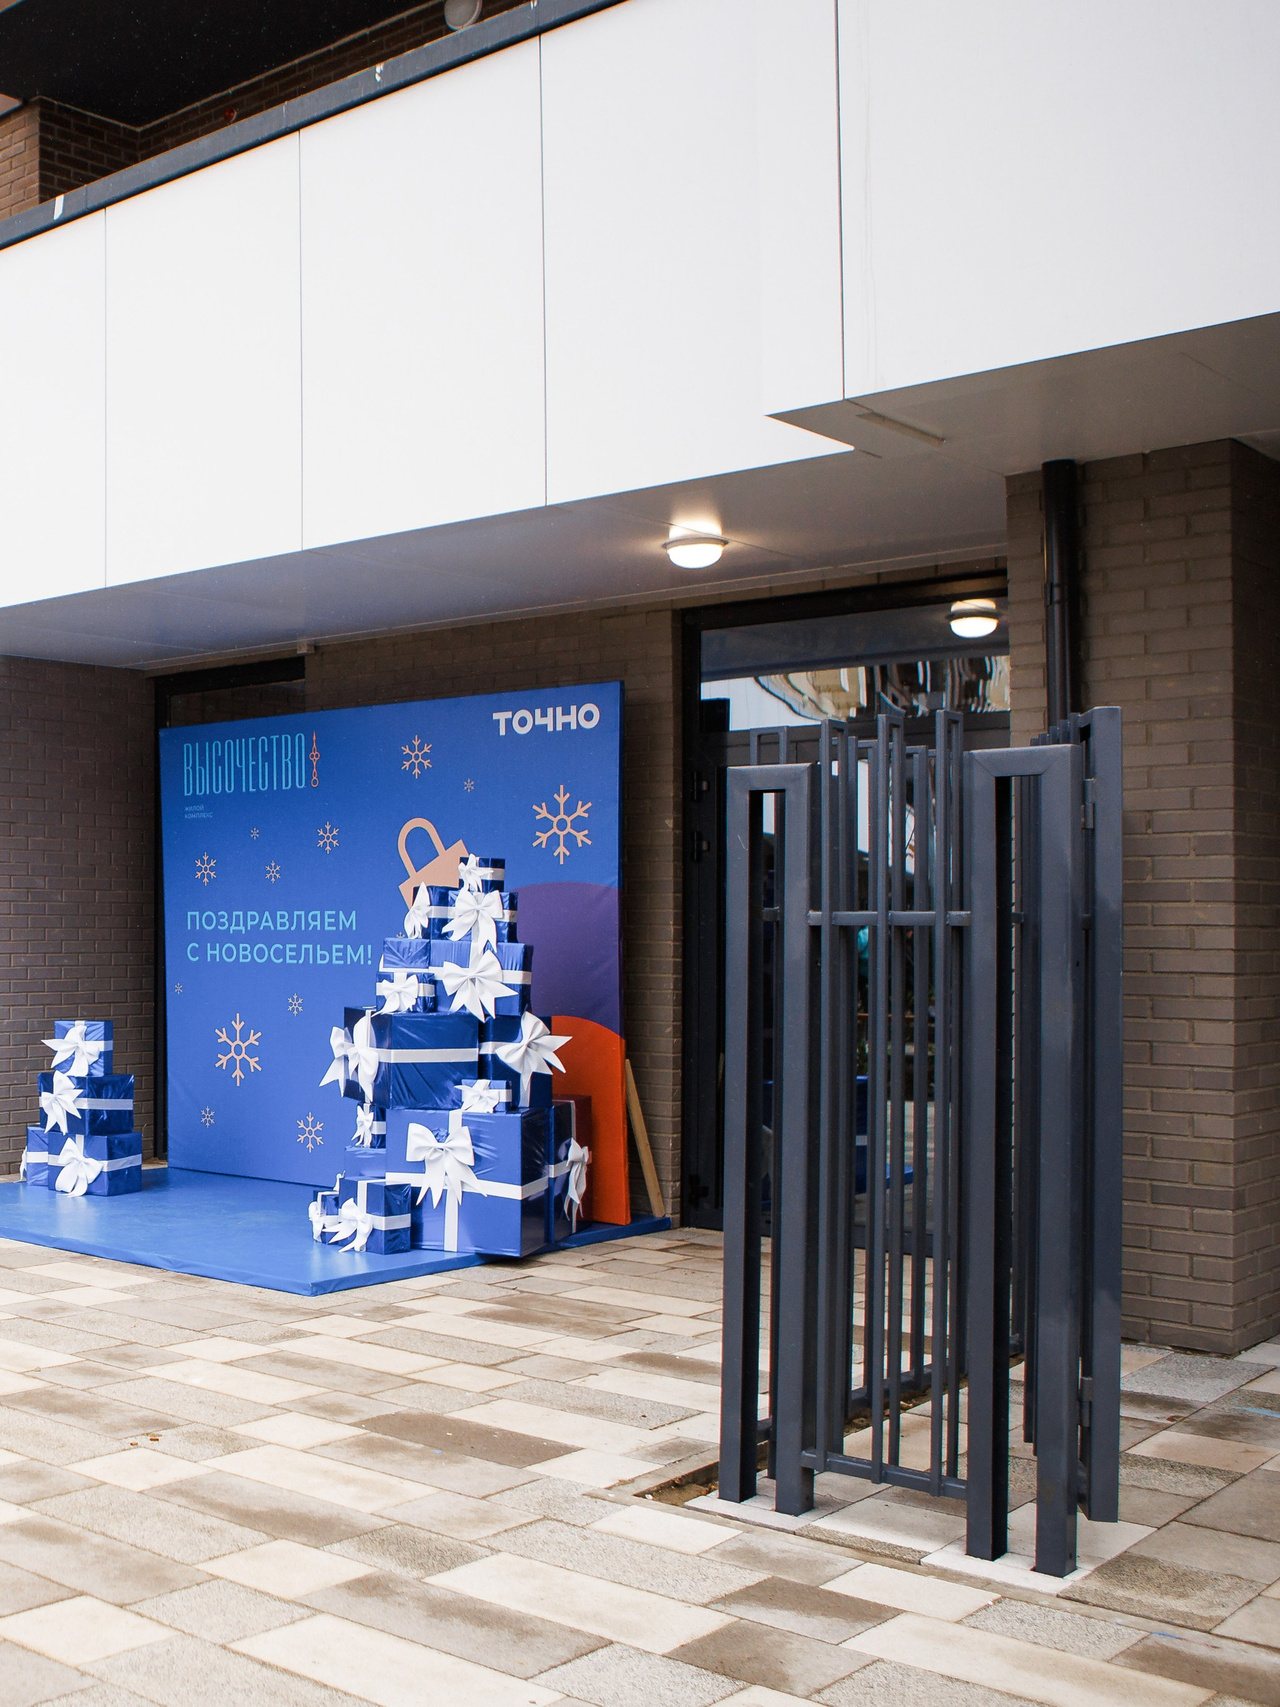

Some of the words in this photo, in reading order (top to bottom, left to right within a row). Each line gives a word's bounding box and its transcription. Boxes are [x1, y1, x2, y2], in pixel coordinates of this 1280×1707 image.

[492, 702, 601, 737] ТОЧНО
[183, 732, 307, 797] ВЫСОЧЕСТВО
[186, 909, 357, 934] ПОЗДРАВЛЯЕМ
[186, 942, 200, 963] С
[206, 943, 373, 966] НОВОСЕЛЬЕМ!
